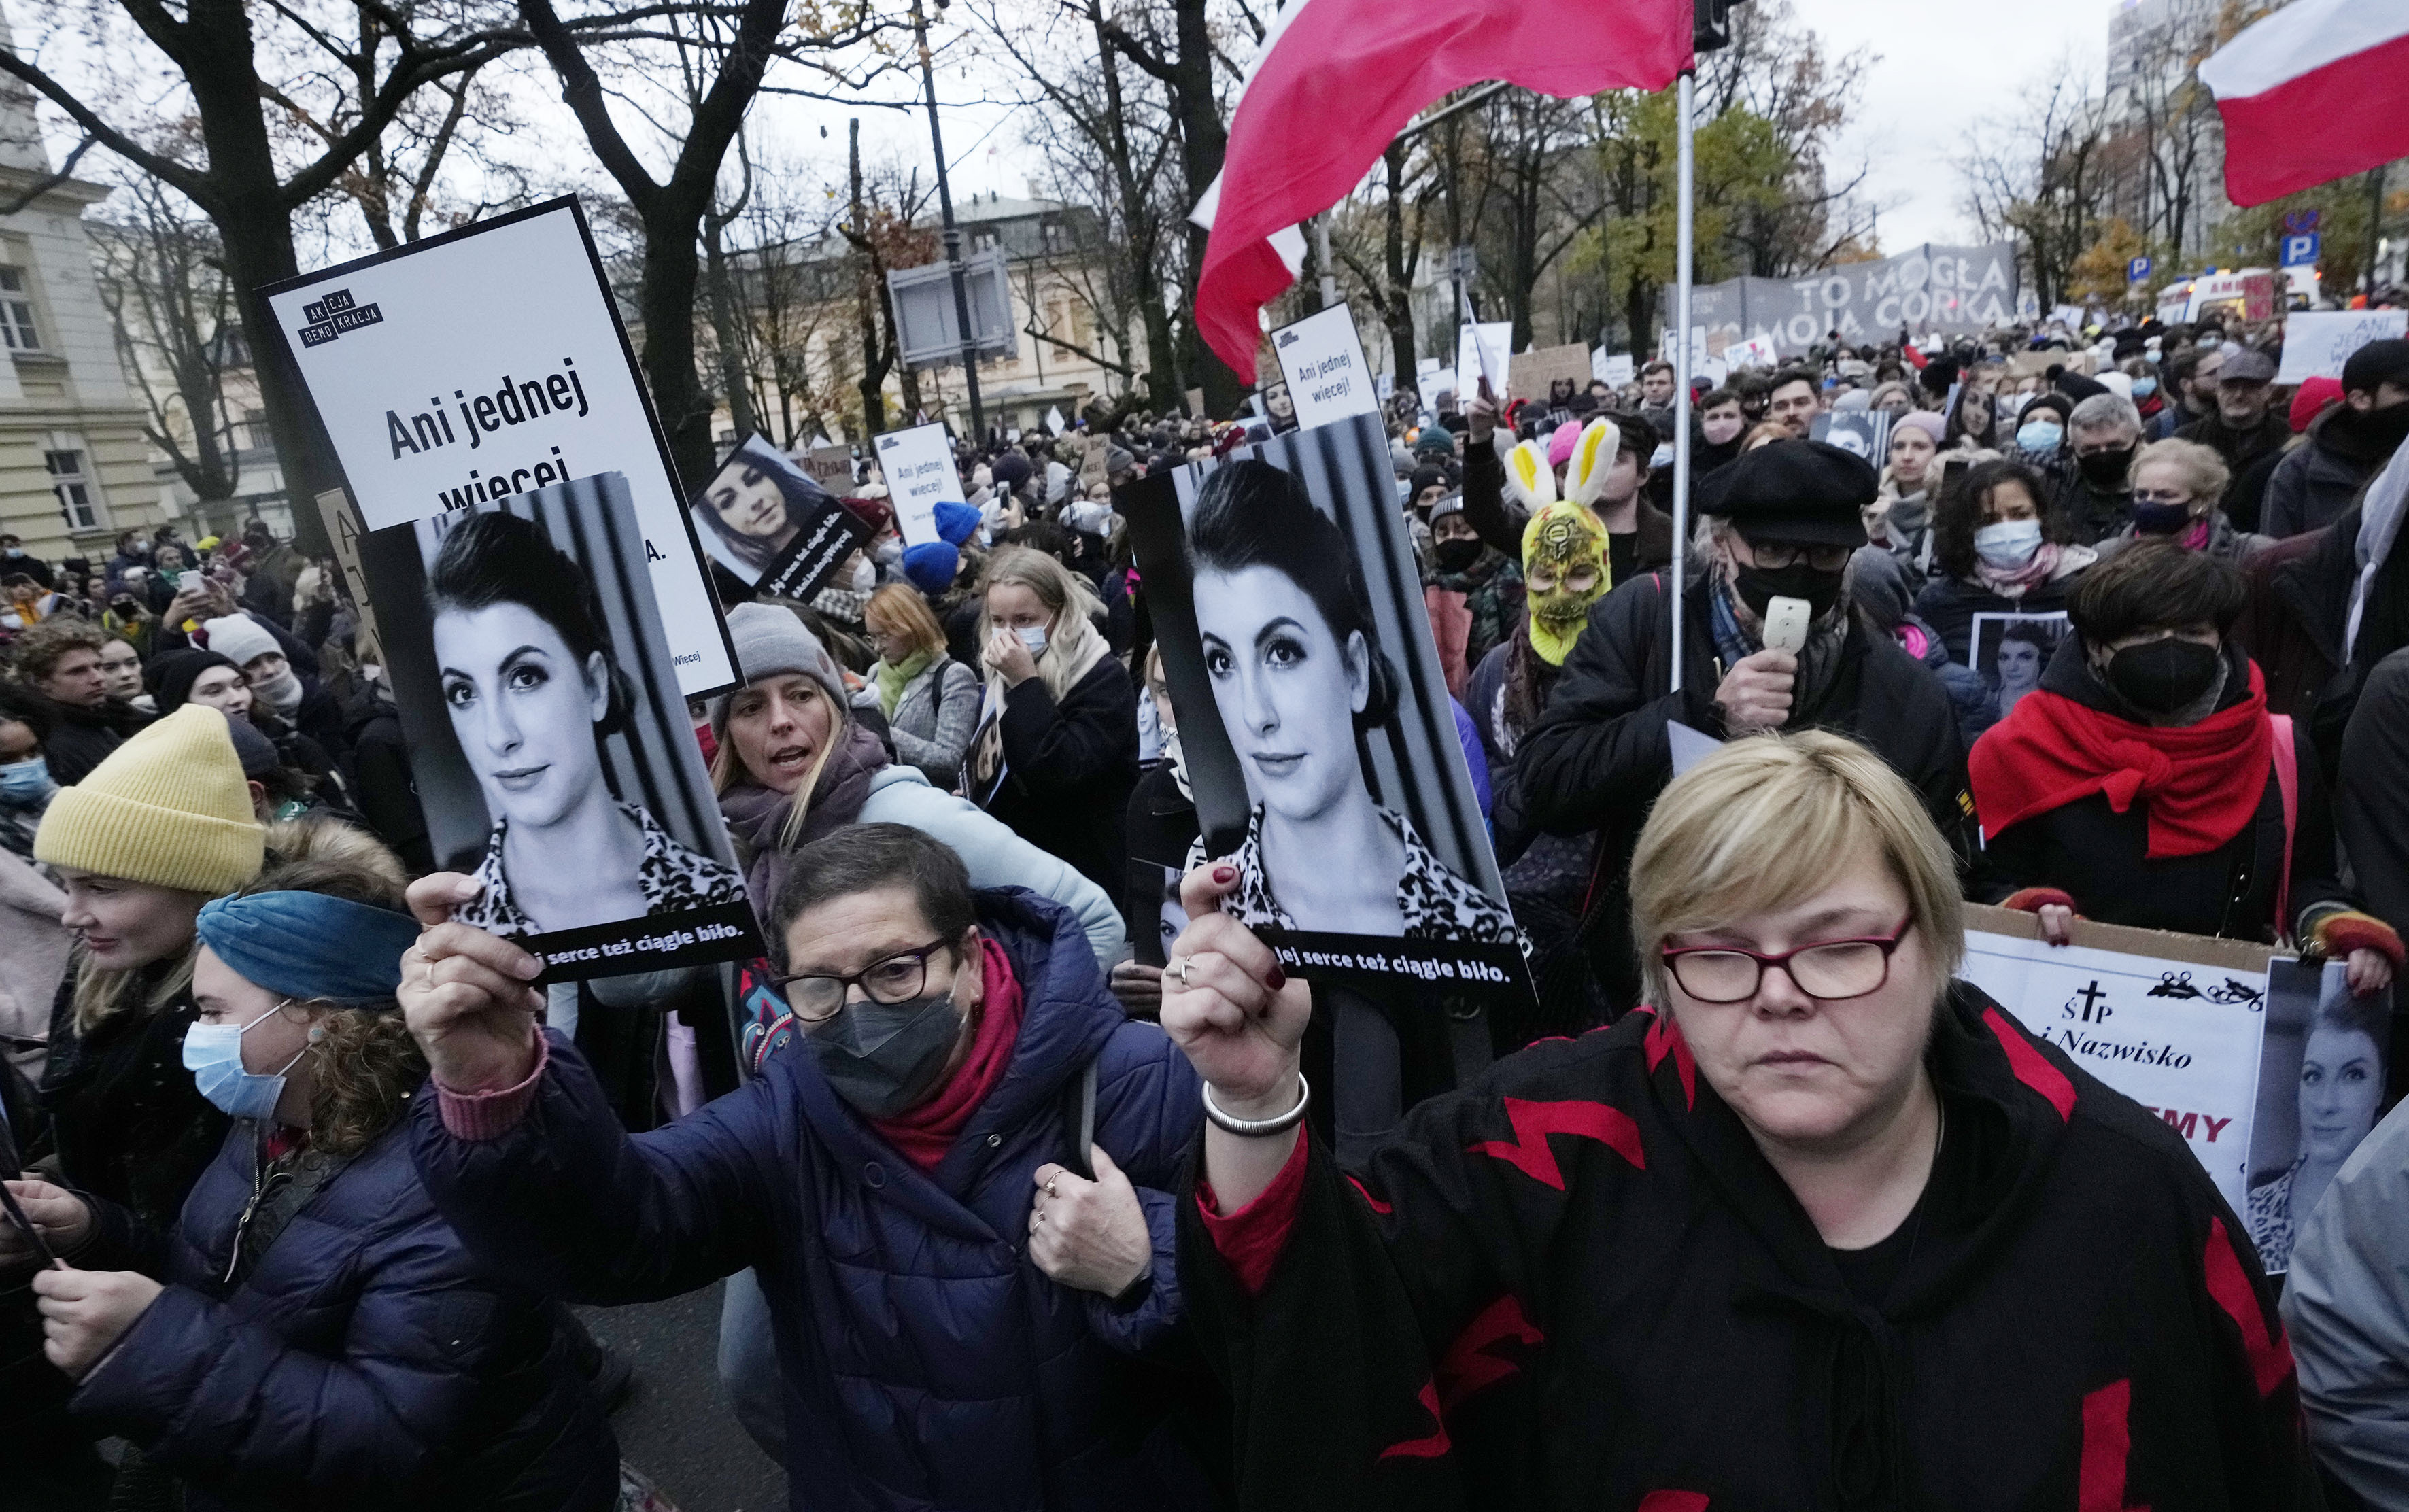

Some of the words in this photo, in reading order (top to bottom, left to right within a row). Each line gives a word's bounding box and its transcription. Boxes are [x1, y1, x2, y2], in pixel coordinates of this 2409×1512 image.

[1792, 275, 1852, 312] TO
[1299, 362, 1317, 383] Ani
[1317, 349, 1352, 379] jednej
[1311, 375, 1352, 404] więcej!
[385, 396, 455, 460] Ani
[454, 356, 589, 449] jednej
[898, 464, 914, 480] Ani
[914, 458, 944, 479] jednej
[546, 946, 600, 965] serce
[600, 938, 635, 957] też
[635, 929, 696, 952] ciągle
[695, 923, 745, 943] biło.
[1301, 950, 1354, 969] serce
[1356, 952, 1390, 972] też
[1393, 955, 1454, 981] ciągle
[1456, 959, 1511, 984] biło.
[2057, 1029, 2193, 1069] Nazwisko
